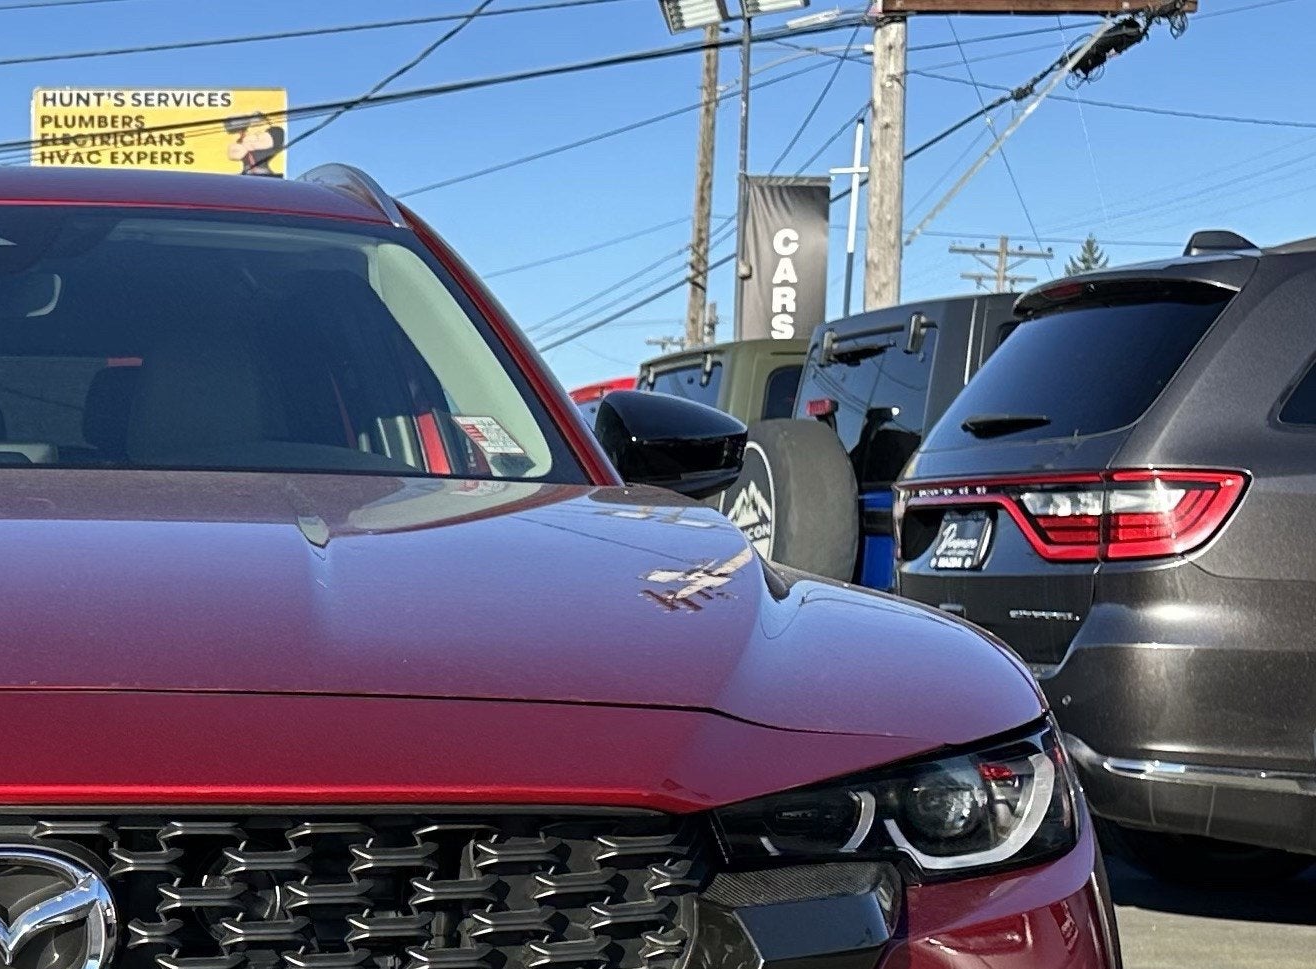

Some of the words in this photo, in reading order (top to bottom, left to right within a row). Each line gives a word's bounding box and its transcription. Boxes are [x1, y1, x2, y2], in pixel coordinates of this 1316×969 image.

[42, 92, 125, 107] HUNT'S
[131, 92, 232, 107] SERVICES
[40, 115, 145, 128] PLUMBERS
[40, 132, 185, 147] ELECTRICIANS
[40, 151, 102, 165] HVAC
[110, 151, 195, 165] EXPERTS
[771, 228, 799, 339] CARS
[744, 522, 771, 540] CON
